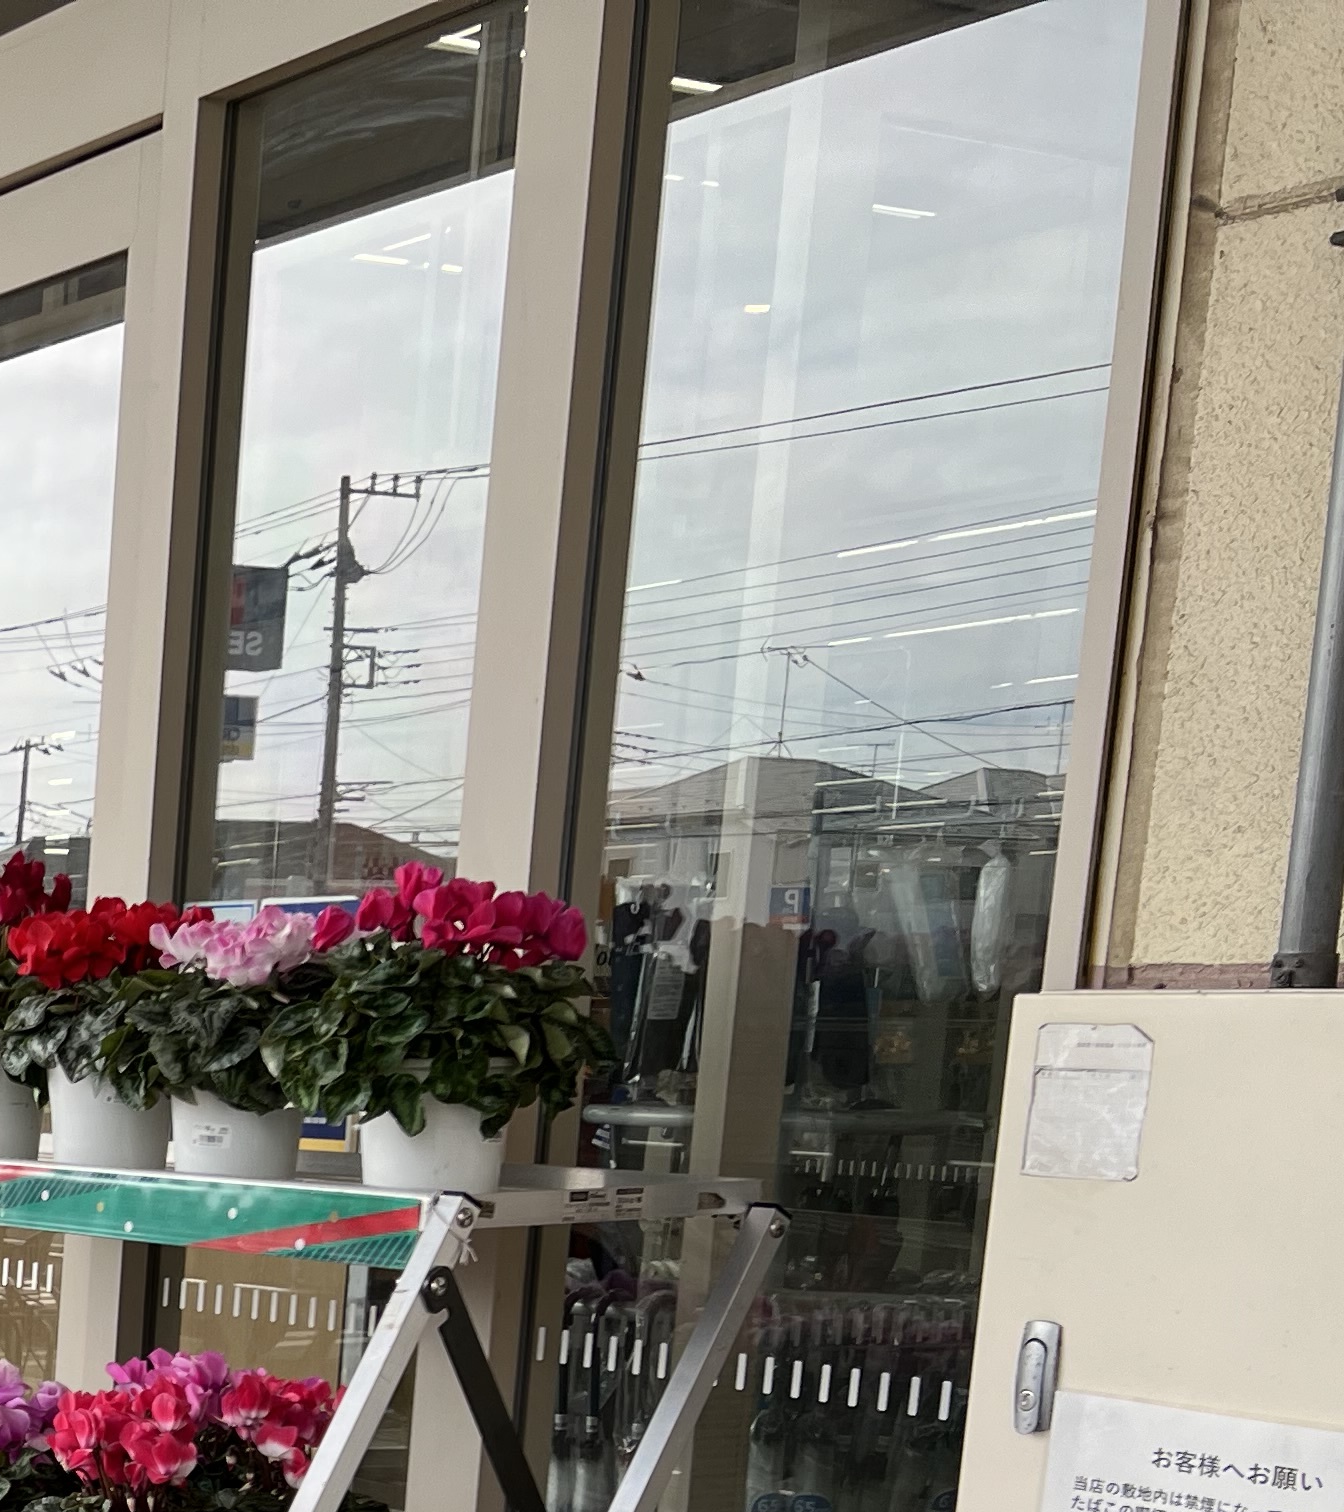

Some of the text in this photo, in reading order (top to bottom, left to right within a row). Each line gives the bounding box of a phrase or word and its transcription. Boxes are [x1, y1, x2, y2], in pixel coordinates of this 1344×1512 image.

[1151, 1447, 1323, 1492] お客様へお願い
